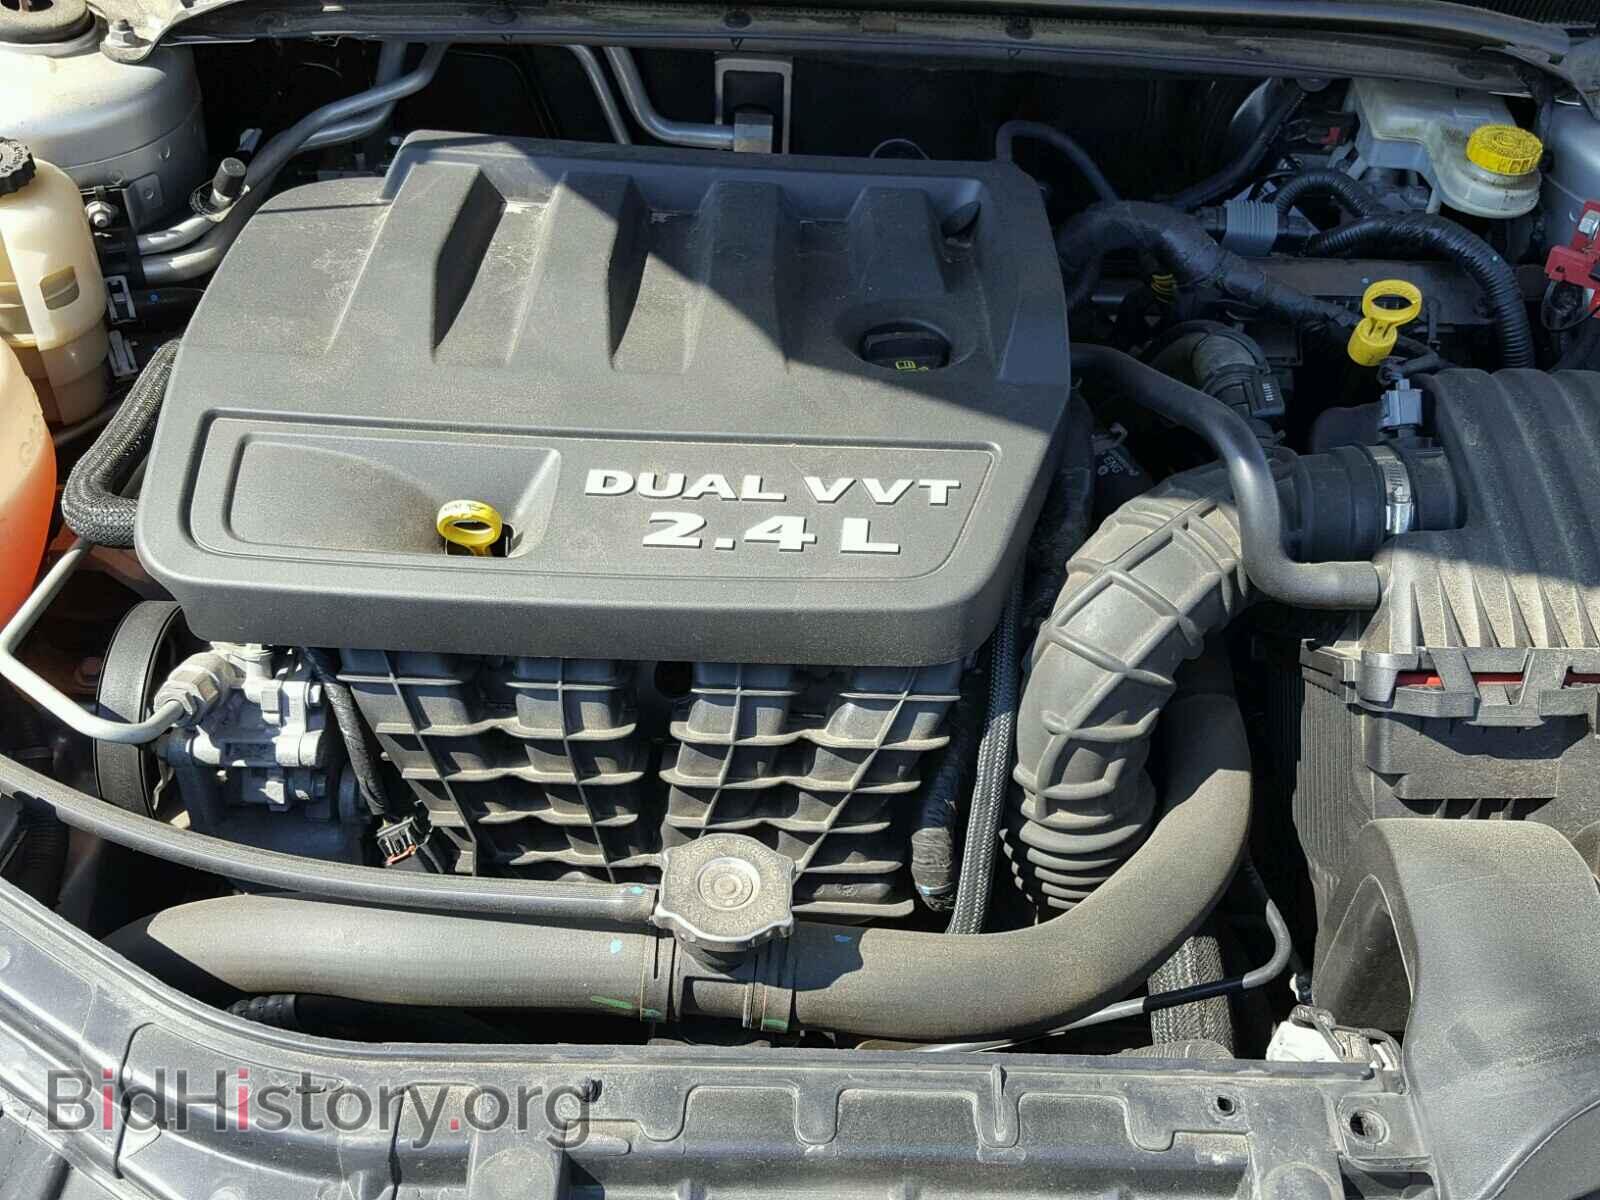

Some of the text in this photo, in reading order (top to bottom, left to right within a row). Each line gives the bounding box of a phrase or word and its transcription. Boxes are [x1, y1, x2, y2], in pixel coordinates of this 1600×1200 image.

[584, 469, 961, 506] DUAL VVT
[642, 511, 900, 554] 2.4 L
